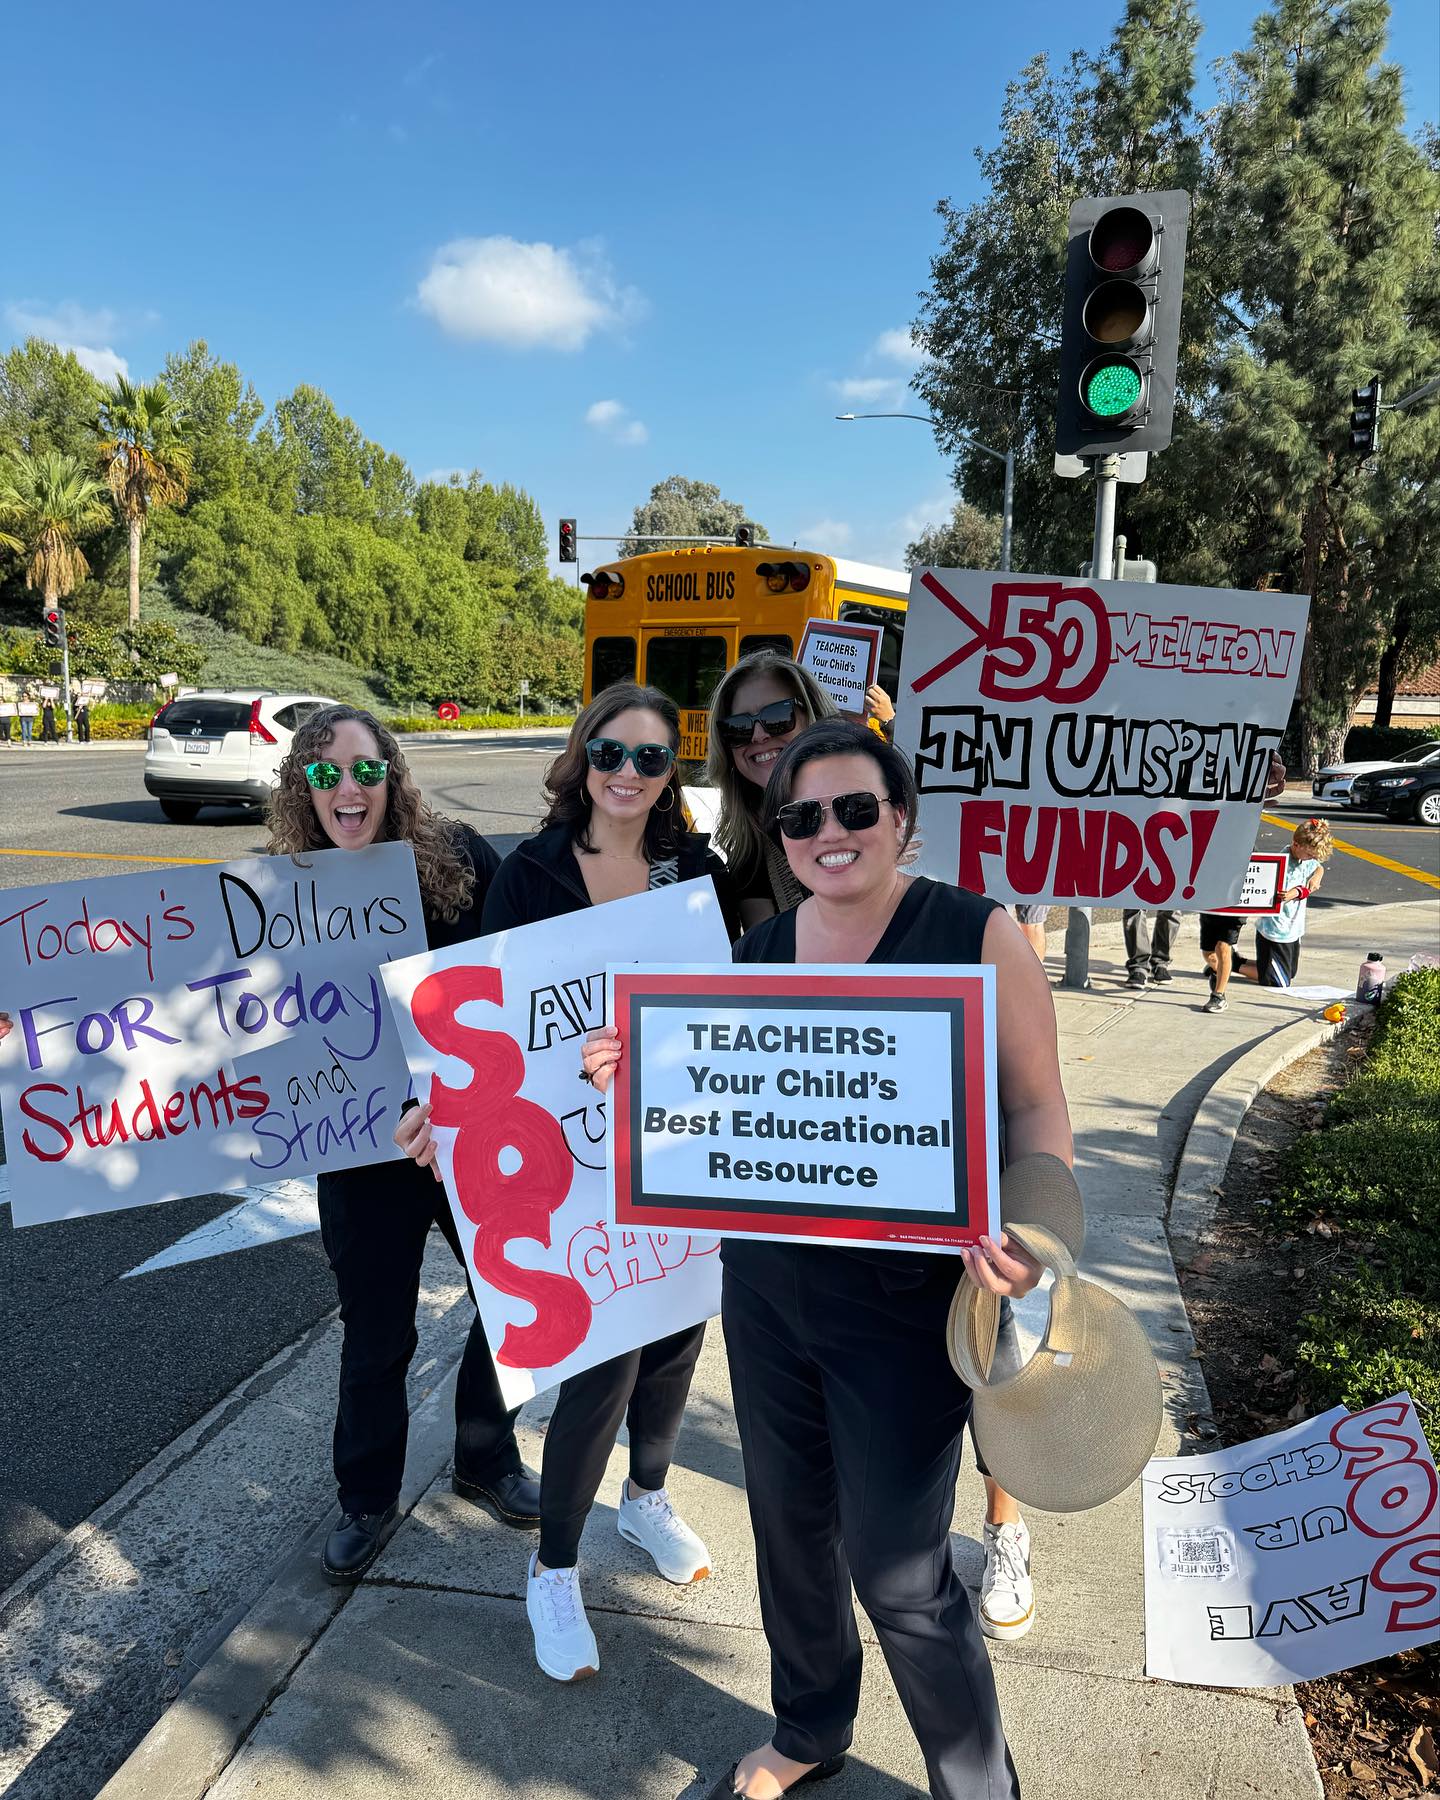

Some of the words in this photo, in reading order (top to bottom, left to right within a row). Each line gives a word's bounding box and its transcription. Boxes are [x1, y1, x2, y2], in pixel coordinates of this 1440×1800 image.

[647, 573, 700, 602] SCHOOL
[706, 571, 735, 600] BUS
[812, 655, 828, 667] Your
[829, 659, 856, 673] Child's
[816, 640, 858, 657] TEACHERS:
[817, 672, 865, 691] Educational
[915, 706, 1033, 795] IN
[1046, 713, 1284, 803] UNSPENT
[958, 800, 1219, 905] FUNDS!
[0, 889, 195, 982] Today's
[219, 871, 407, 959] Dollars
[528, 972, 606, 1051] AV
[19, 997, 182, 1070] FOR
[687, 1024, 896, 1056] TEACHERS:
[687, 1065, 765, 1095] Your
[776, 1069, 898, 1100] Child's
[19, 1068, 270, 1162] Students
[286, 1050, 357, 1106] and
[644, 1107, 721, 1136] Best
[732, 1110, 950, 1147] Educational
[709, 1152, 878, 1187] Resource
[1243, 1506, 1347, 1550] UR
[1171, 1563, 1198, 1573] HERE
[1201, 1563, 1230, 1573] SCAN
